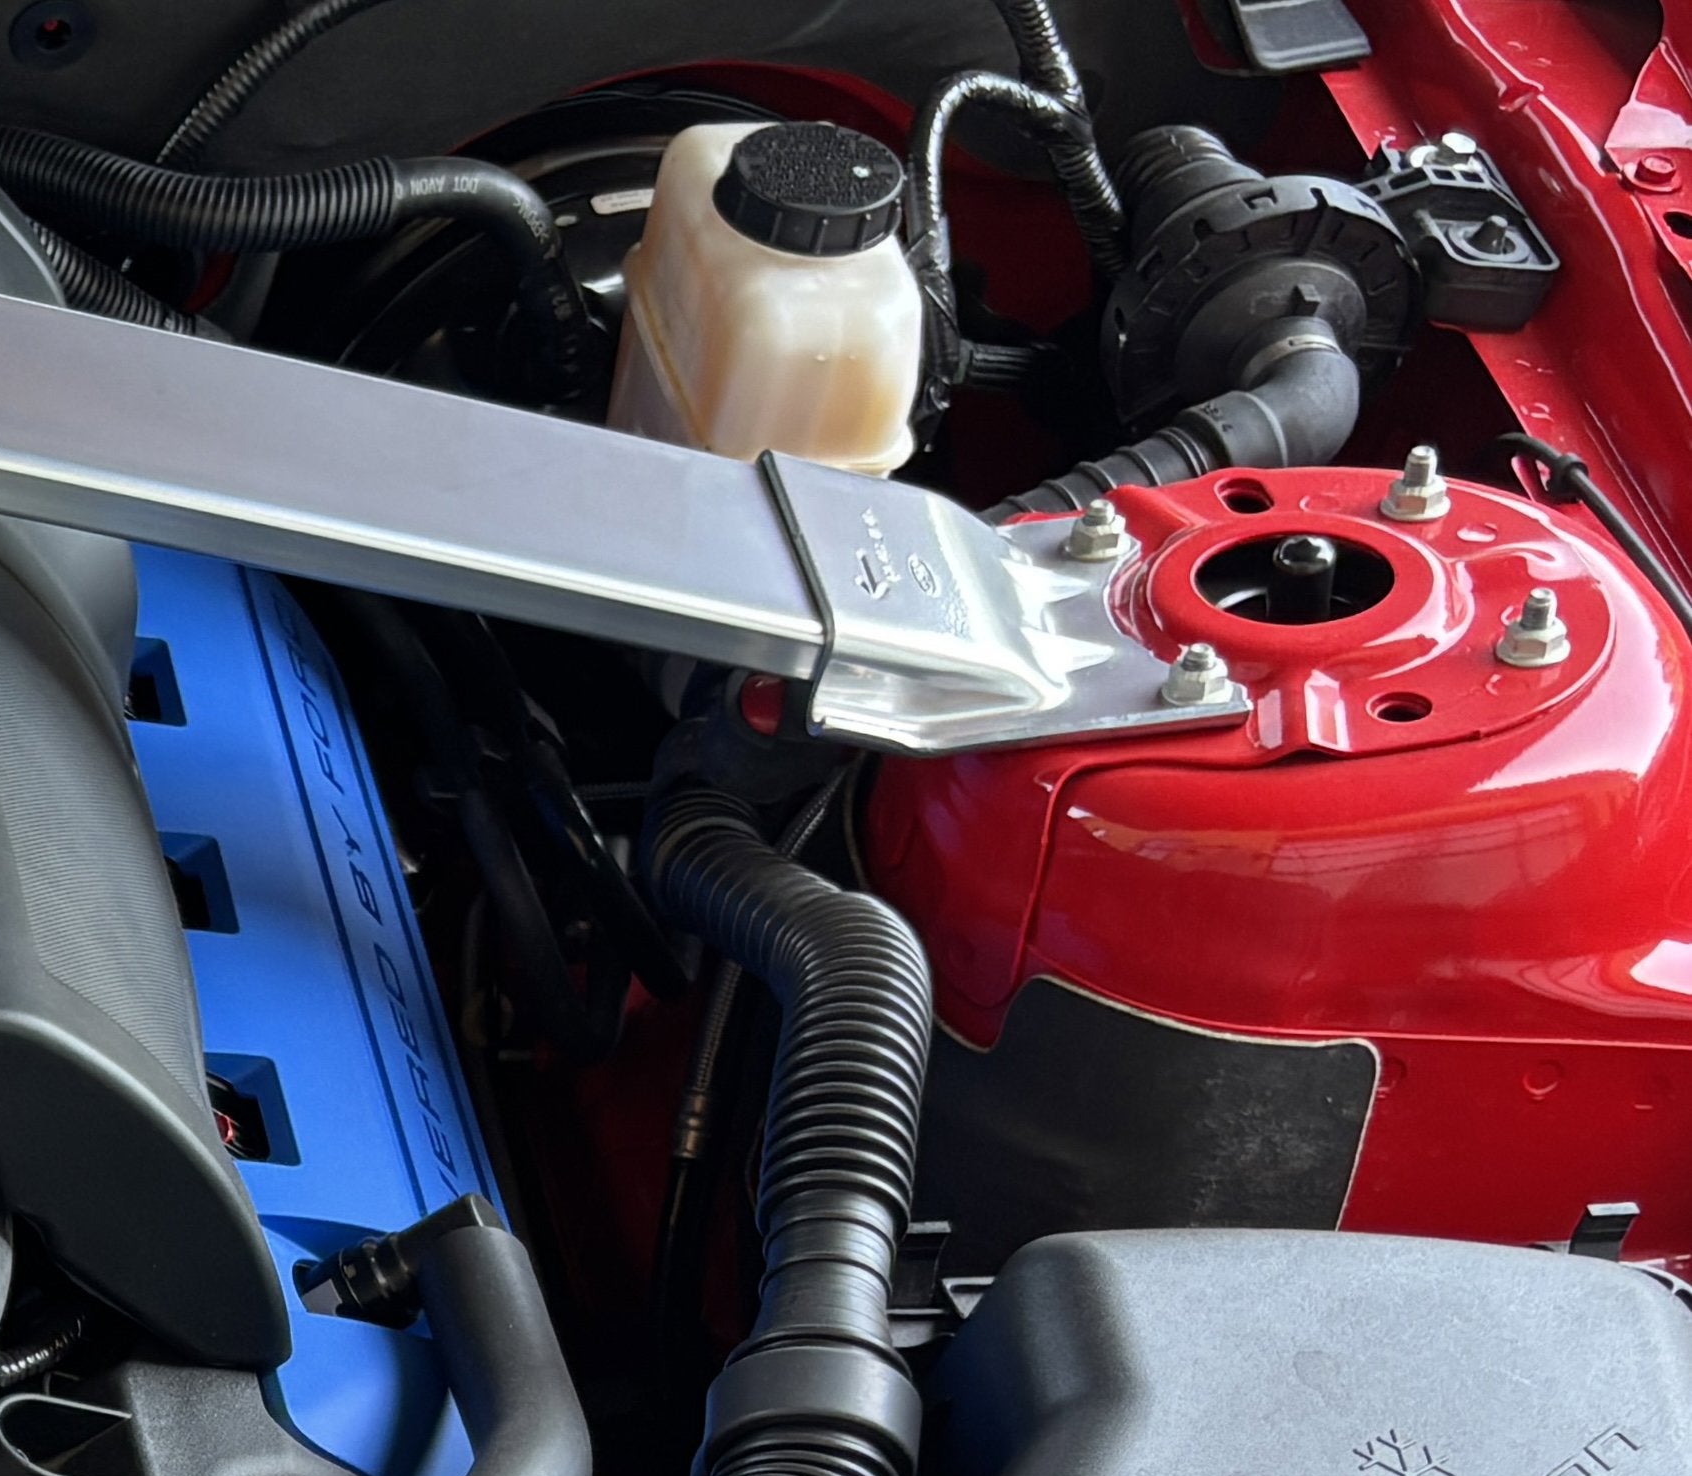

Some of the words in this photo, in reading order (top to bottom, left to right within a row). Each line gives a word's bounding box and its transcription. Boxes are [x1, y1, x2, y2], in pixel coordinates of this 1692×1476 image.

[410, 174, 446, 195] AVON
[453, 176, 479, 194] DOT
[330, 802, 385, 927] BY
